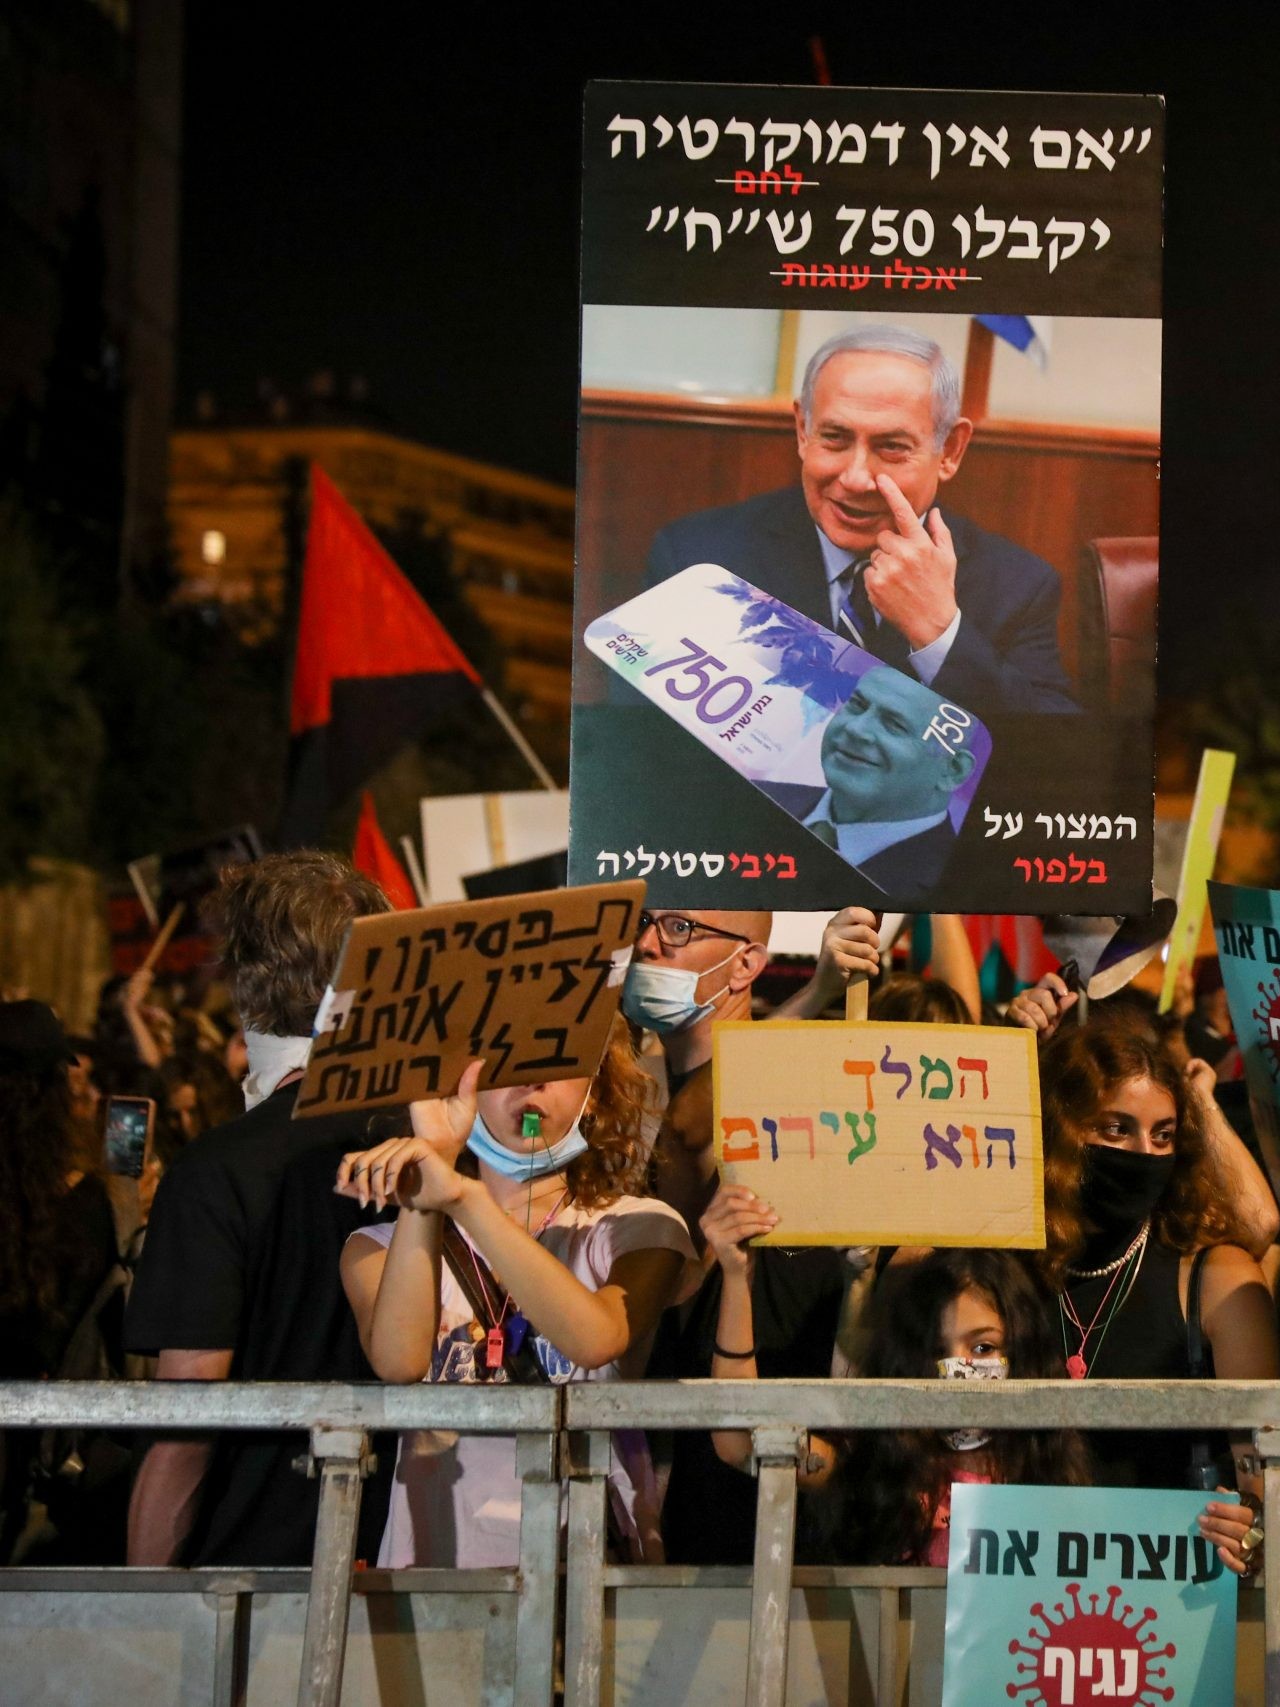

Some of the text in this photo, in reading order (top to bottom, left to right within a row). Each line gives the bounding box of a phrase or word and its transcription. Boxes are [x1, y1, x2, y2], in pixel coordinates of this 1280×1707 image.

[607, 113, 905, 171] דמוקרטיה
[922, 122, 1011, 180] אין
[734, 165, 803, 196] לחם
[836, 205, 935, 257] 750
[952, 205, 1111, 274] יקבלו
[781, 258, 967, 291] יאכלו עוגות
[606, 640, 638, 665] חדשים
[617, 633, 649, 658] שקלים
[644, 637, 753, 724] 750
[719, 694, 773, 741] בנק ישראל
[922, 703, 972, 755] 750
[984, 807, 1137, 841] המצור על
[597, 846, 798, 881] ביביסטיליה
[1013, 853, 1107, 884] בלפור
[1221, 920, 1256, 961] את
[311, 943, 616, 1060] לזיין אותנו
[299, 1023, 579, 1110] בלי רשות
[843, 1045, 988, 1111] המלך
[721, 1111, 1016, 1171] הוא עירום
[964, 1528, 1225, 1585] עוצרים את
[1043, 1646, 1139, 1705] נגיף
